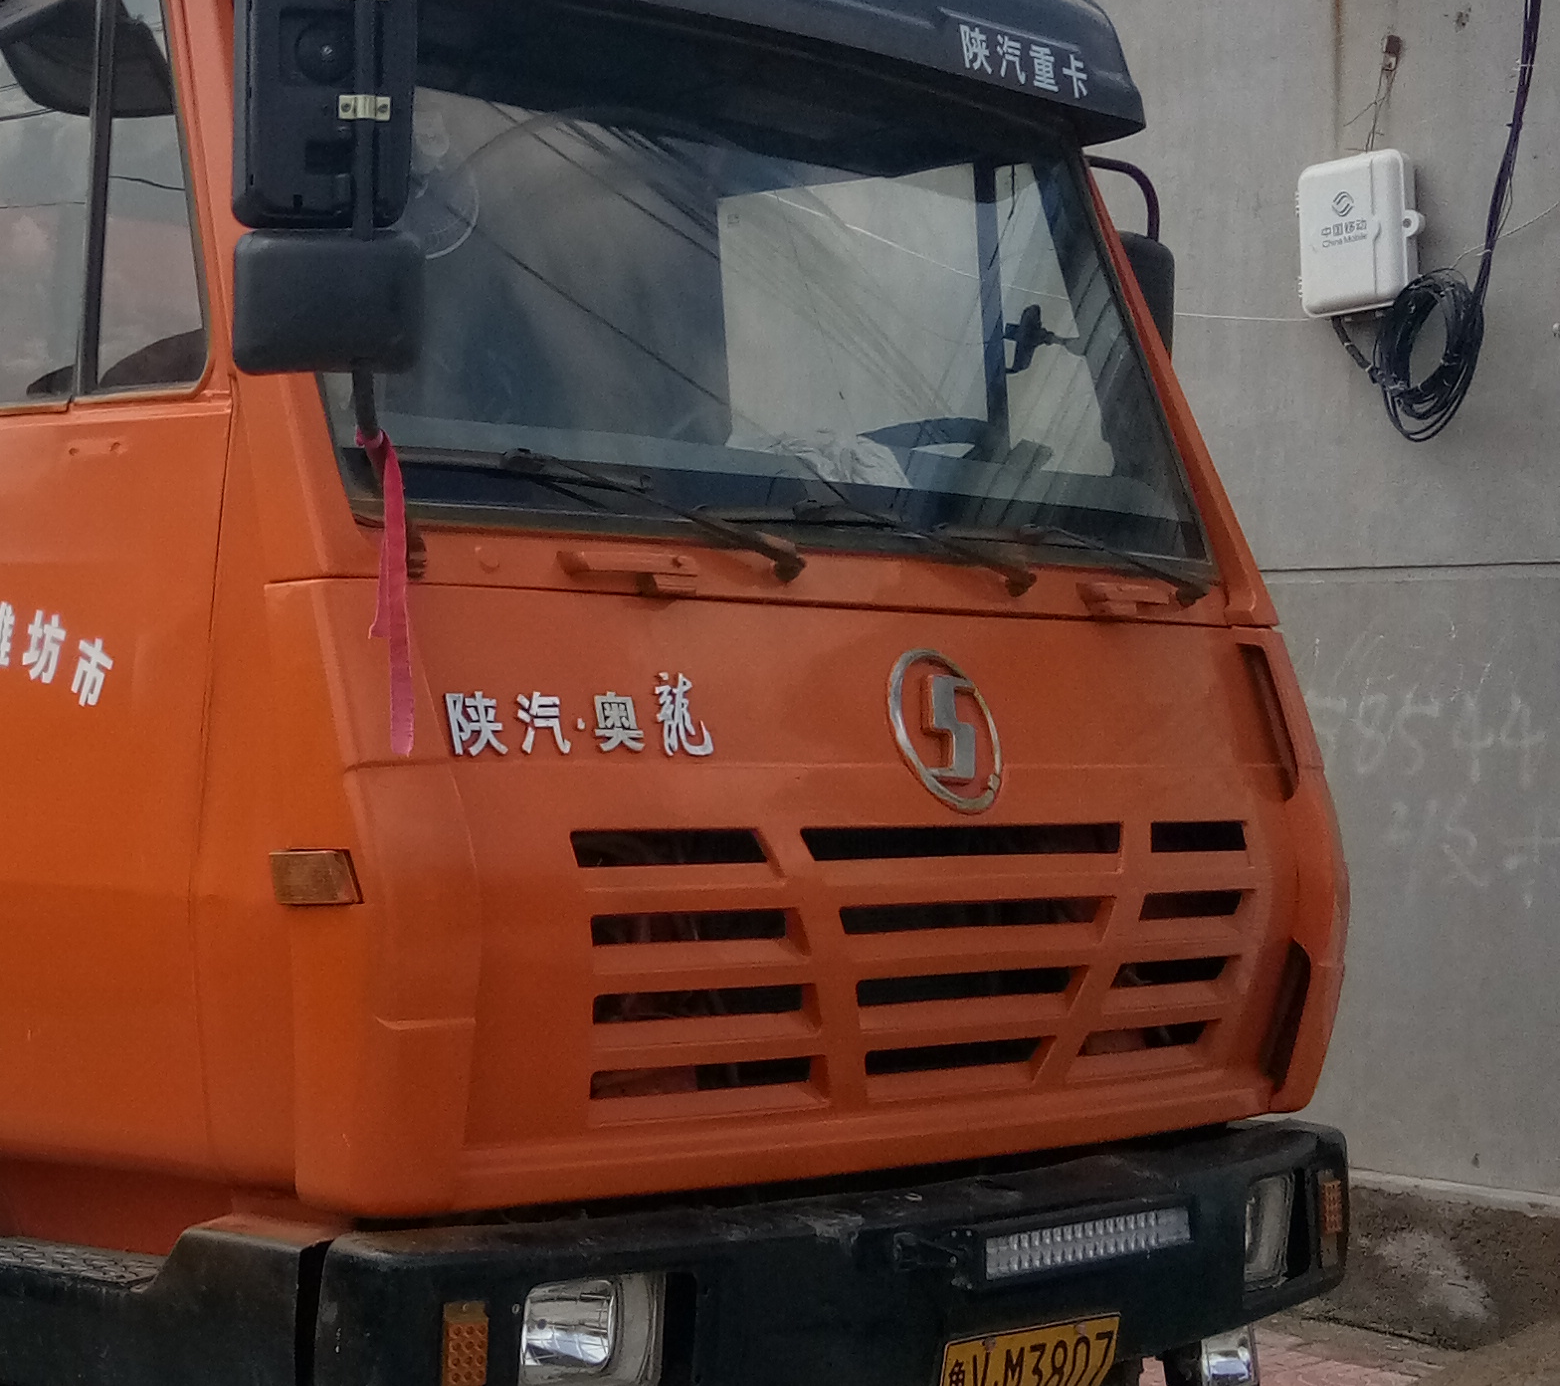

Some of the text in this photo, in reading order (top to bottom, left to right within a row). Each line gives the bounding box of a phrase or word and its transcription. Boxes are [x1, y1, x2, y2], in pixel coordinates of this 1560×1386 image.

[959, 23, 1089, 100] 陕汽重卡
[1320, 219, 1368, 238] 中国移动
[1322, 233, 1368, 248] China Mobile
